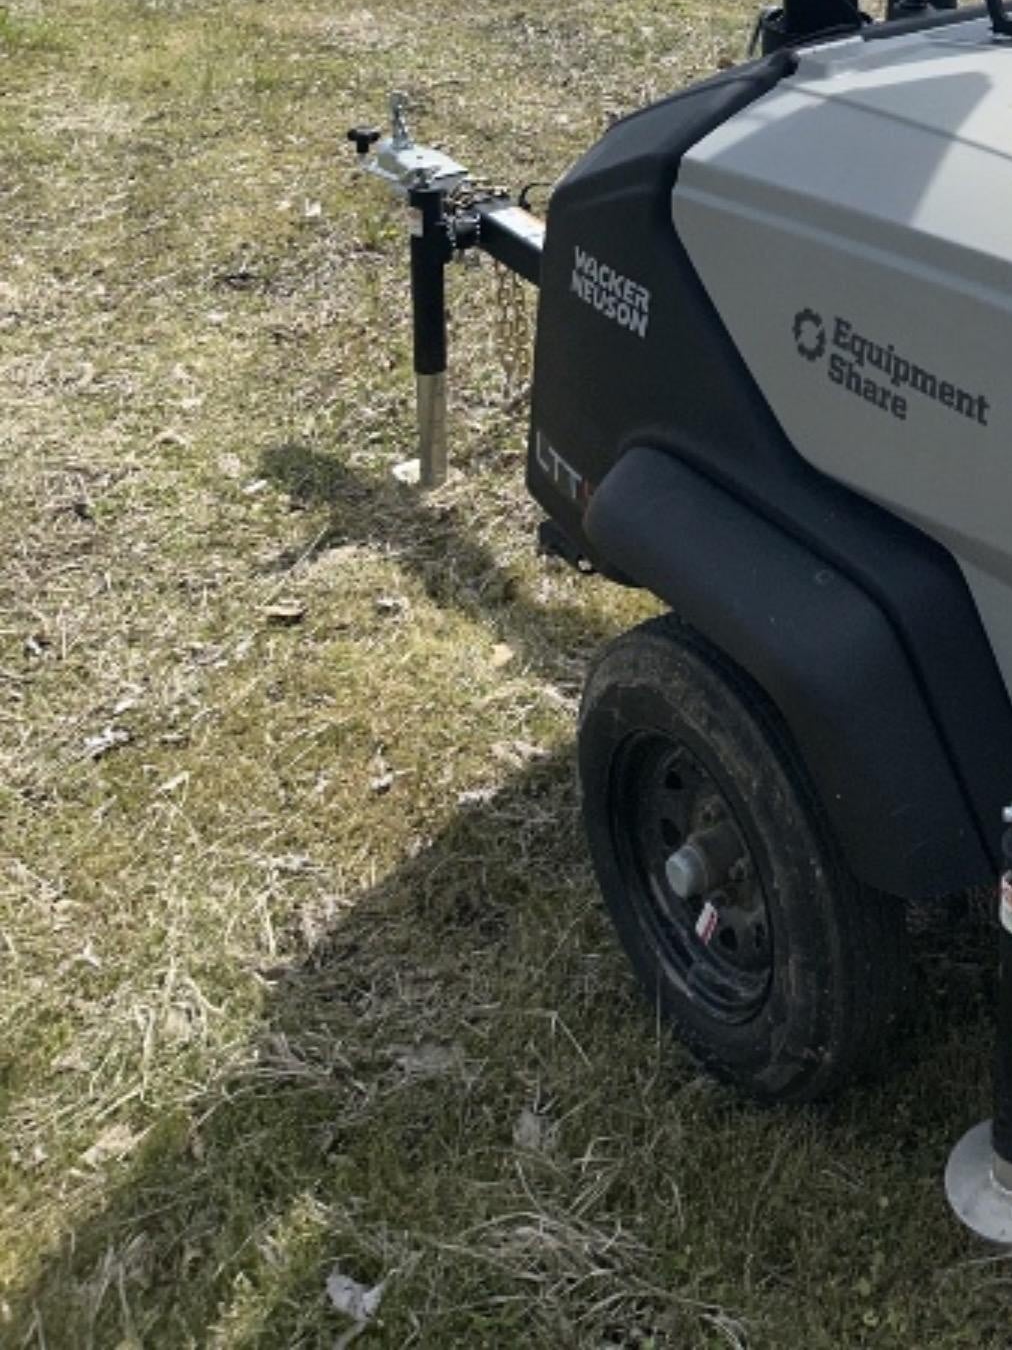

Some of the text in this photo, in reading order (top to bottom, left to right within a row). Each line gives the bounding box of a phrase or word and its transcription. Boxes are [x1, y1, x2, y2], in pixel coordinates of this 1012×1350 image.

[570, 269, 649, 339] NEUSON
[575, 245, 650, 313] WACKER
[828, 353, 908, 422] Share
[833, 317, 990, 427] Equipment
[536, 430, 594, 501] LTT
